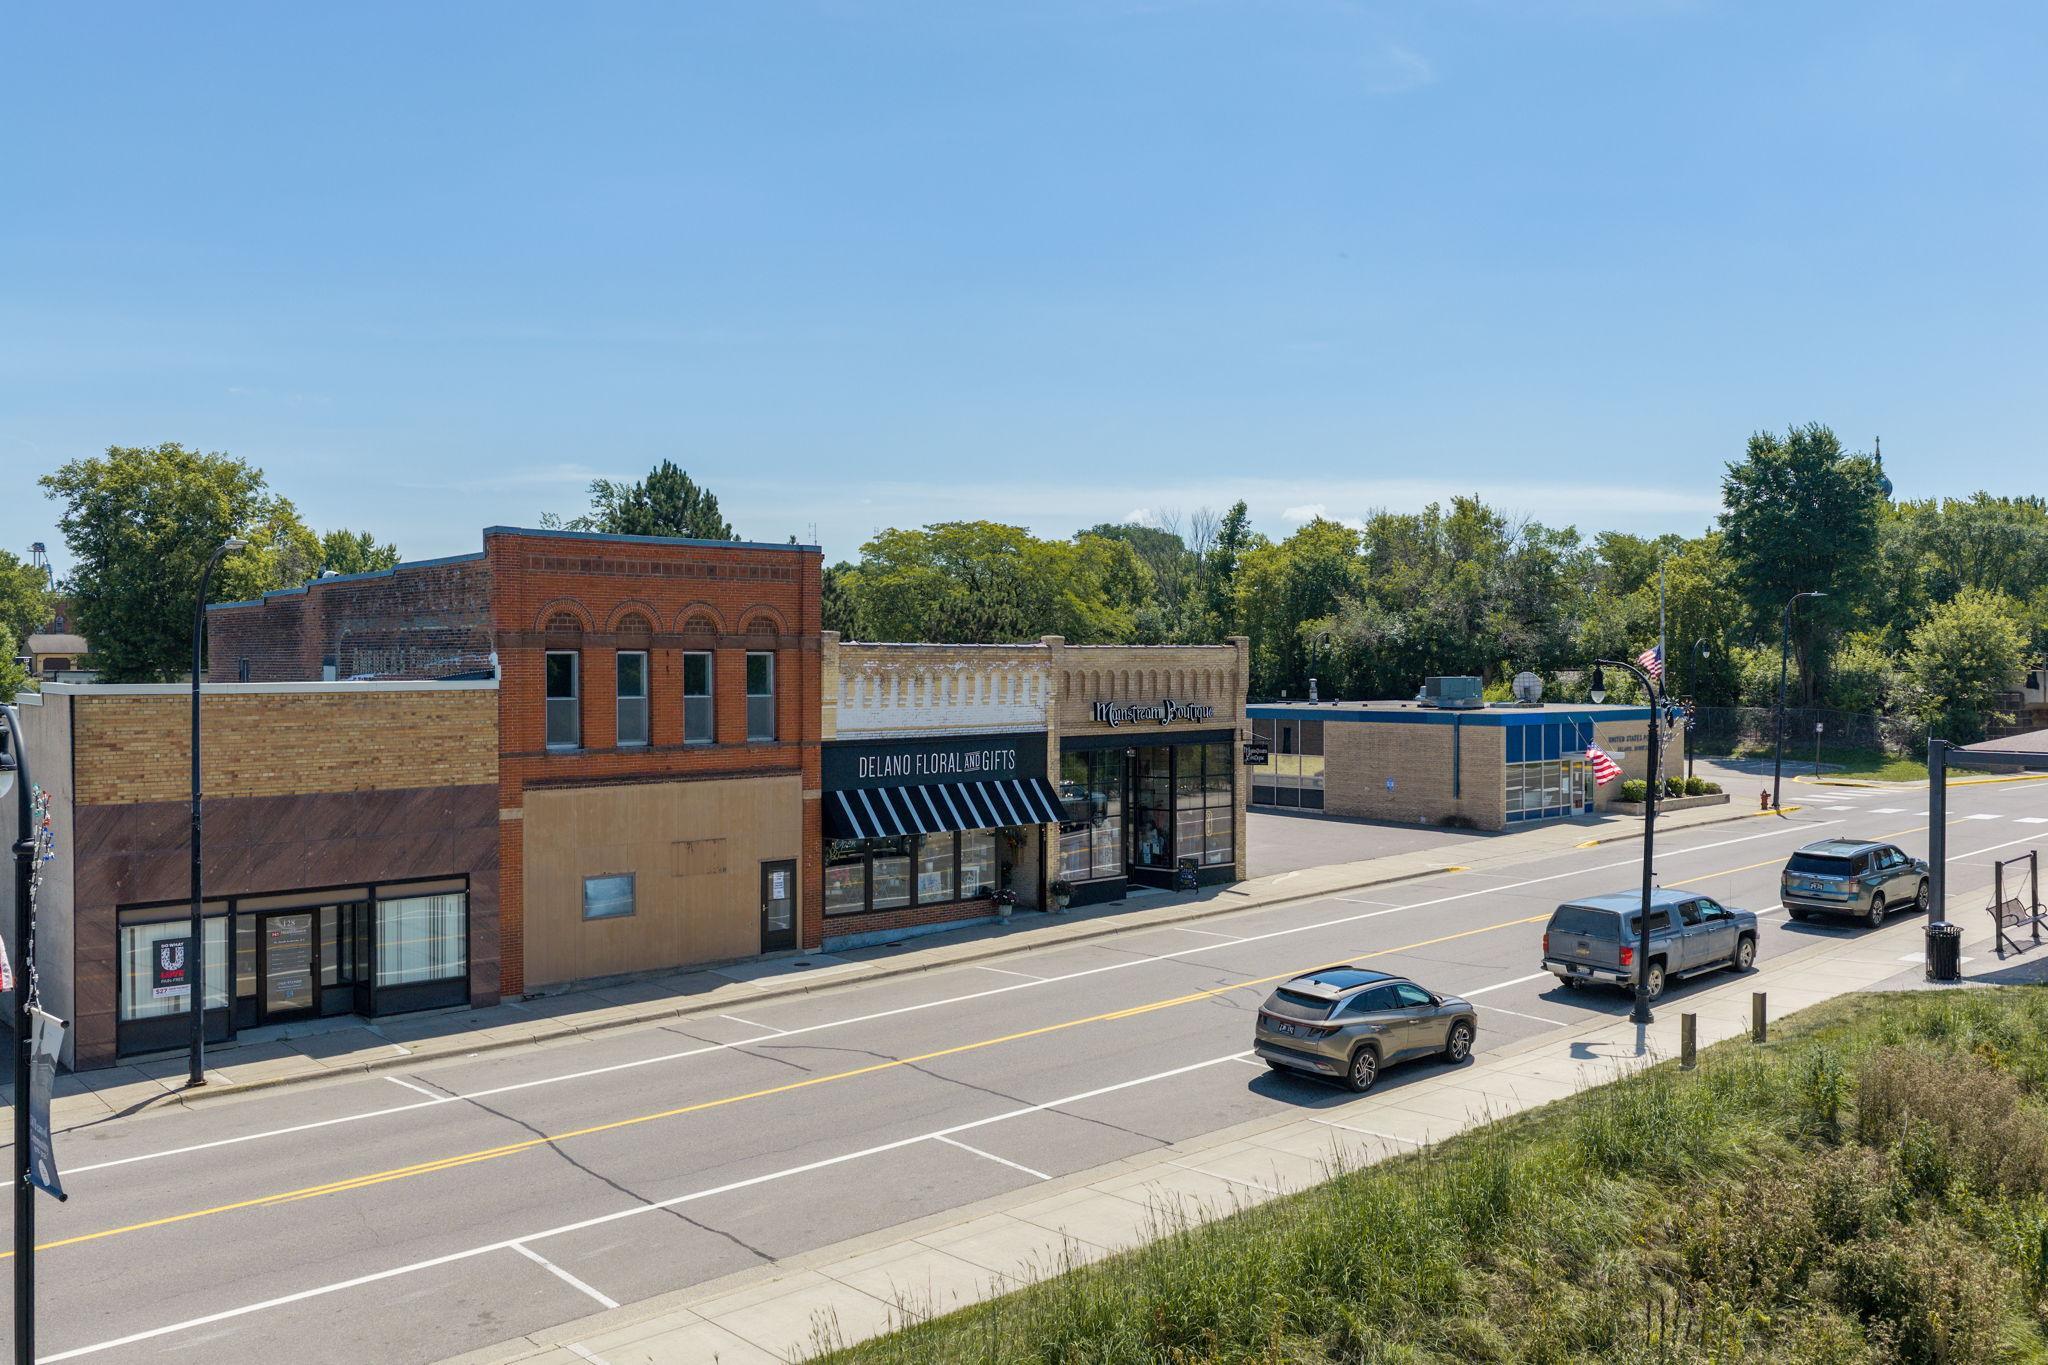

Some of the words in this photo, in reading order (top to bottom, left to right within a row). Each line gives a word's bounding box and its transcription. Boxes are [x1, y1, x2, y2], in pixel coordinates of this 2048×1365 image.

[1094, 701, 1160, 728] Mainstream
[1161, 699, 1214, 726] Boutique
[859, 754, 911, 778] DELANO
[916, 752, 963, 775] FLORAL
[964, 752, 981, 771] AND
[982, 749, 1016, 771] GIFTS
[160, 947, 184, 971] U
